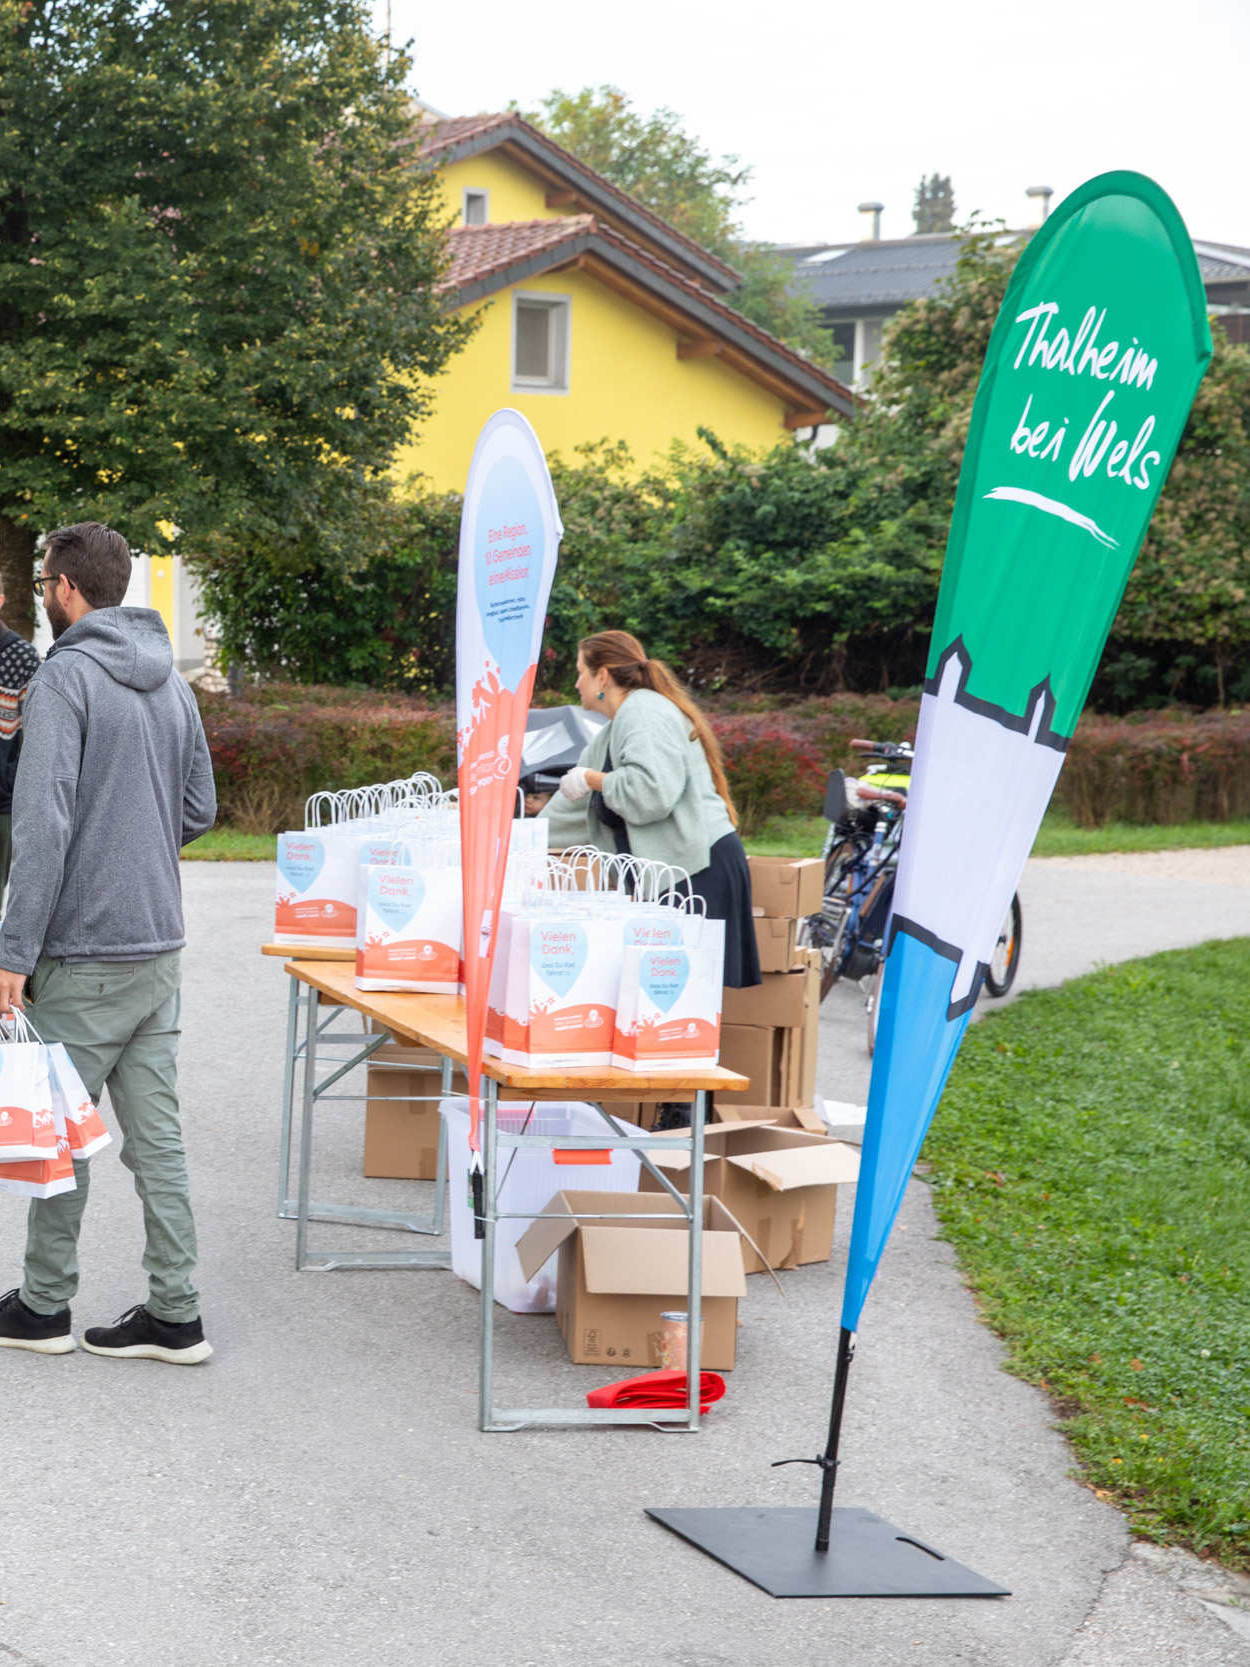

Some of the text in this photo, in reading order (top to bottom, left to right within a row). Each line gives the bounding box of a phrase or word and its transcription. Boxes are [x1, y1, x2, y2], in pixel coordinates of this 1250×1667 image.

[1013, 301, 1158, 391] Thalheim
[1010, 389, 1161, 490] bei Wels
[285, 842, 316, 851] Vielen
[379, 874, 414, 885] Vielen
[379, 886, 412, 897] Dank,
[540, 931, 576, 942] Vielen
[633, 928, 671, 939] Vielen
[542, 944, 575, 956] Dank,
[650, 957, 681, 965] Vielen
[651, 968, 679, 978] Dank,
